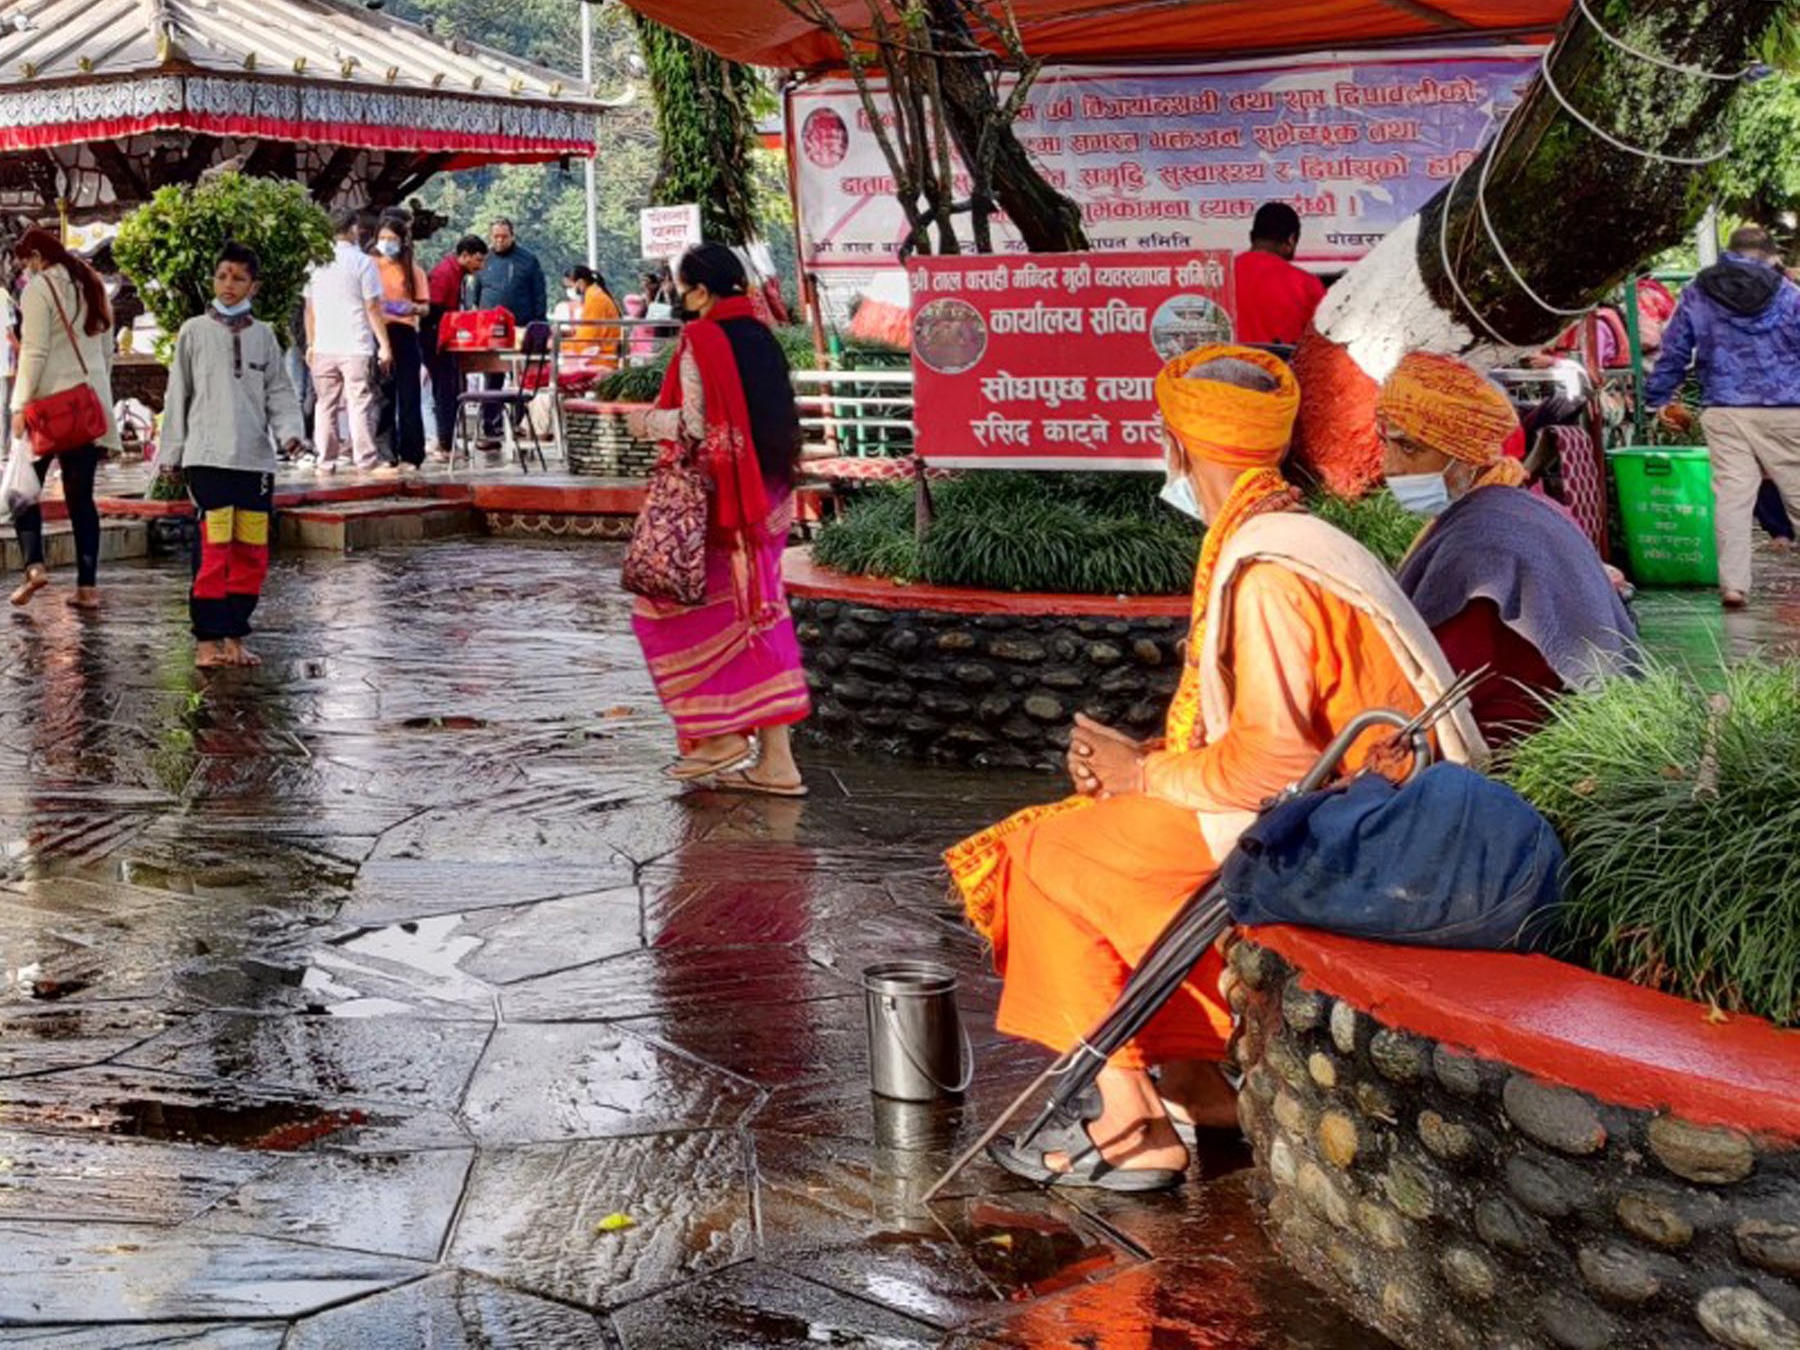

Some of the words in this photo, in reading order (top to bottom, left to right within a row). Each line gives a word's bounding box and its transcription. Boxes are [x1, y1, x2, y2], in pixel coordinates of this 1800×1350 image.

[911, 265, 929, 293] श्री
[931, 270, 962, 293] ताल
[1011, 261, 1059, 290] मन्दिर
[1174, 259, 1225, 290] समिति
[990, 300, 1085, 335] कार्यालय
[1089, 297, 1148, 336] सचिव
[1096, 375, 1155, 402] तथा
[970, 411, 1032, 447] रसिद
[1042, 413, 1111, 450] काट्ने
